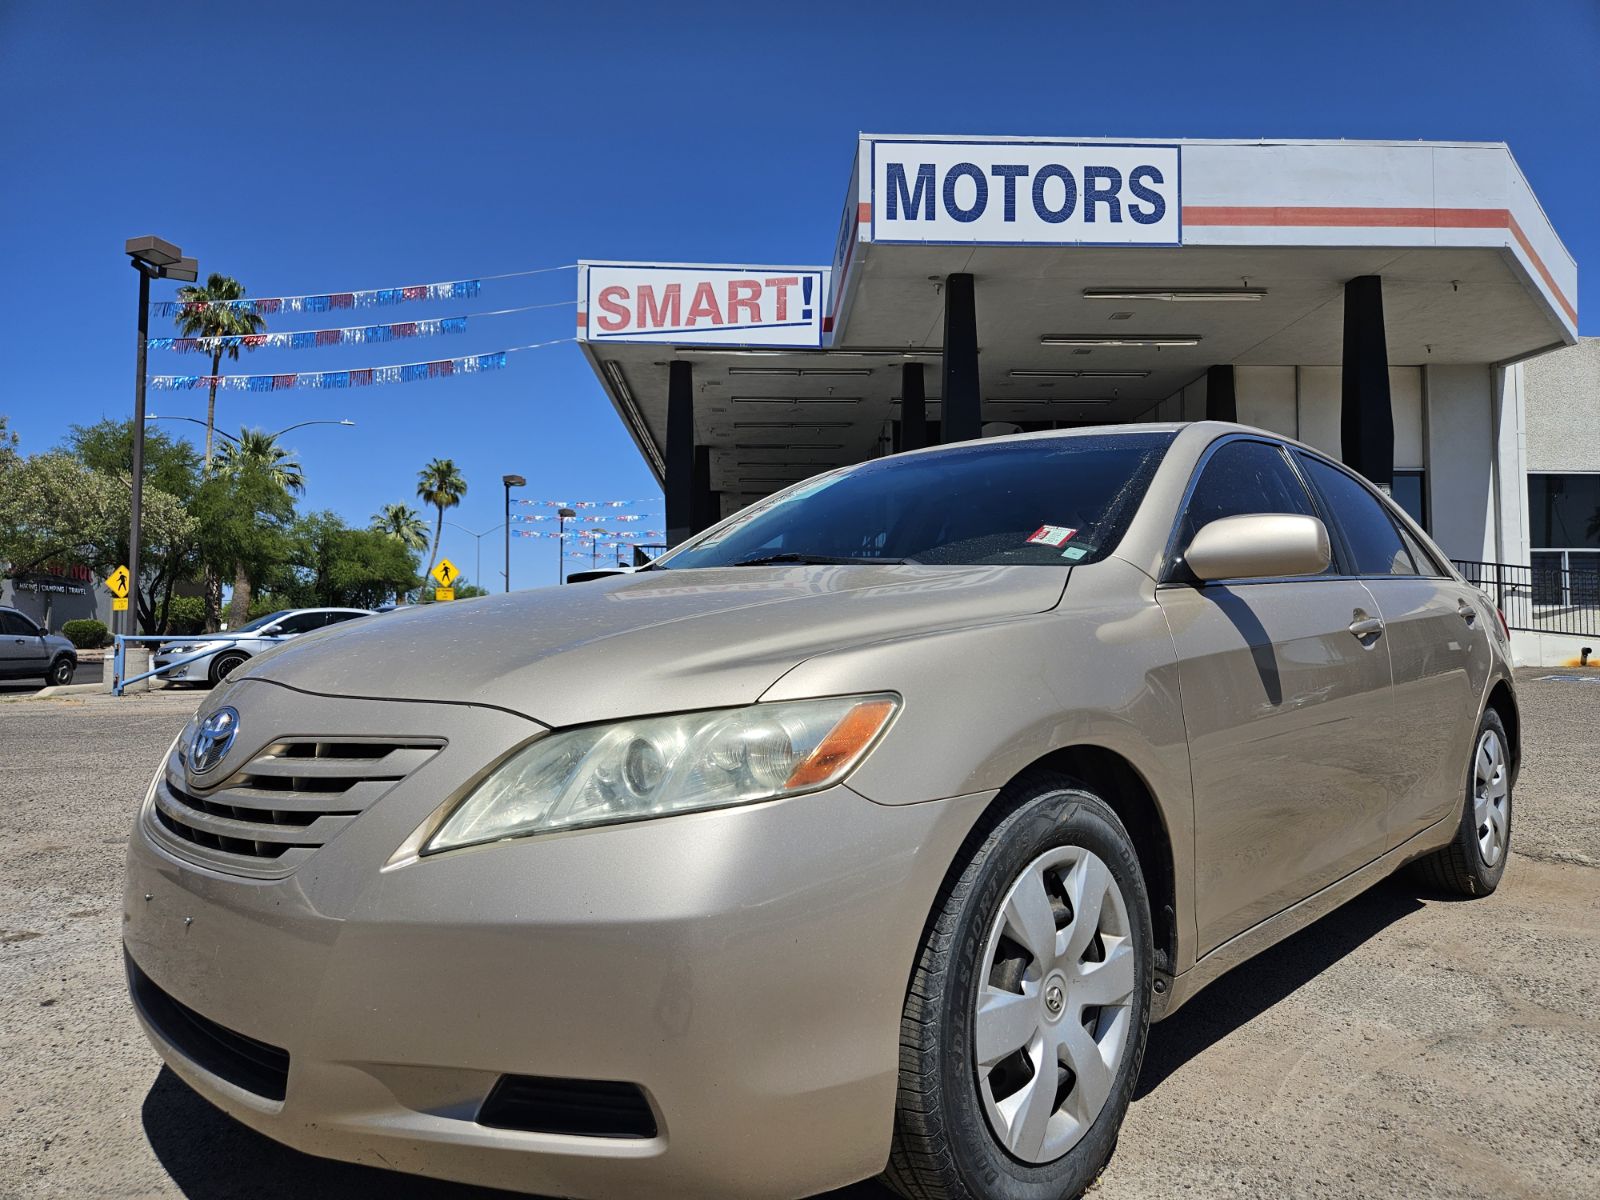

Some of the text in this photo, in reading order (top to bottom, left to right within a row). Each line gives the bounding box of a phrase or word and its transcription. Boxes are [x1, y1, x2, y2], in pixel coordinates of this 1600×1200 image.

[885, 162, 1166, 225] MOTORS
[596, 276, 813, 331] SMART!
[41, 584, 65, 593] CAMPING
[68, 586, 87, 595] TRAVEL
